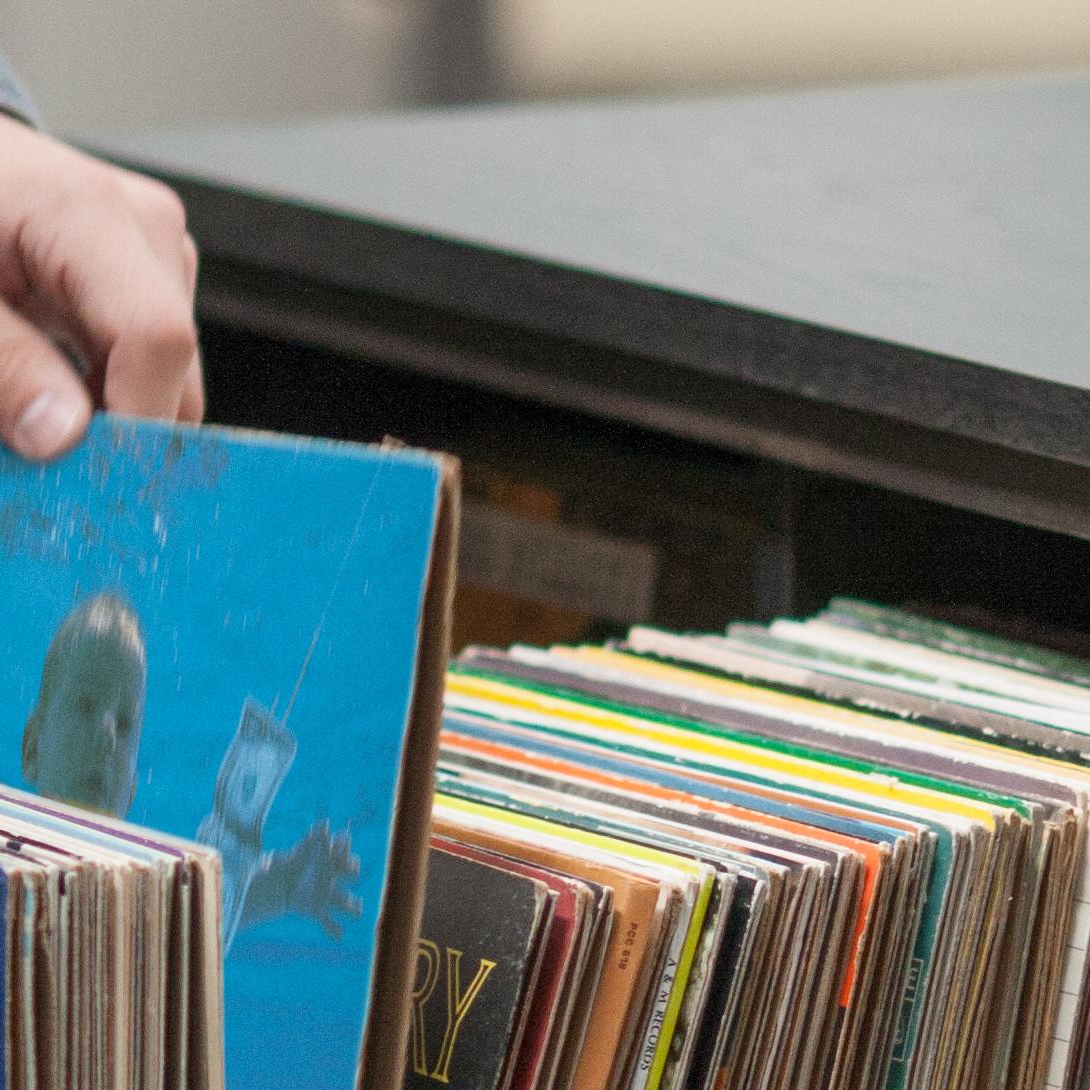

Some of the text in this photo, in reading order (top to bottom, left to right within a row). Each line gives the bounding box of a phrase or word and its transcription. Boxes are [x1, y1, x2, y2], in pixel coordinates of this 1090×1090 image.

[641, 957, 677, 1071] A & M RECORDS
